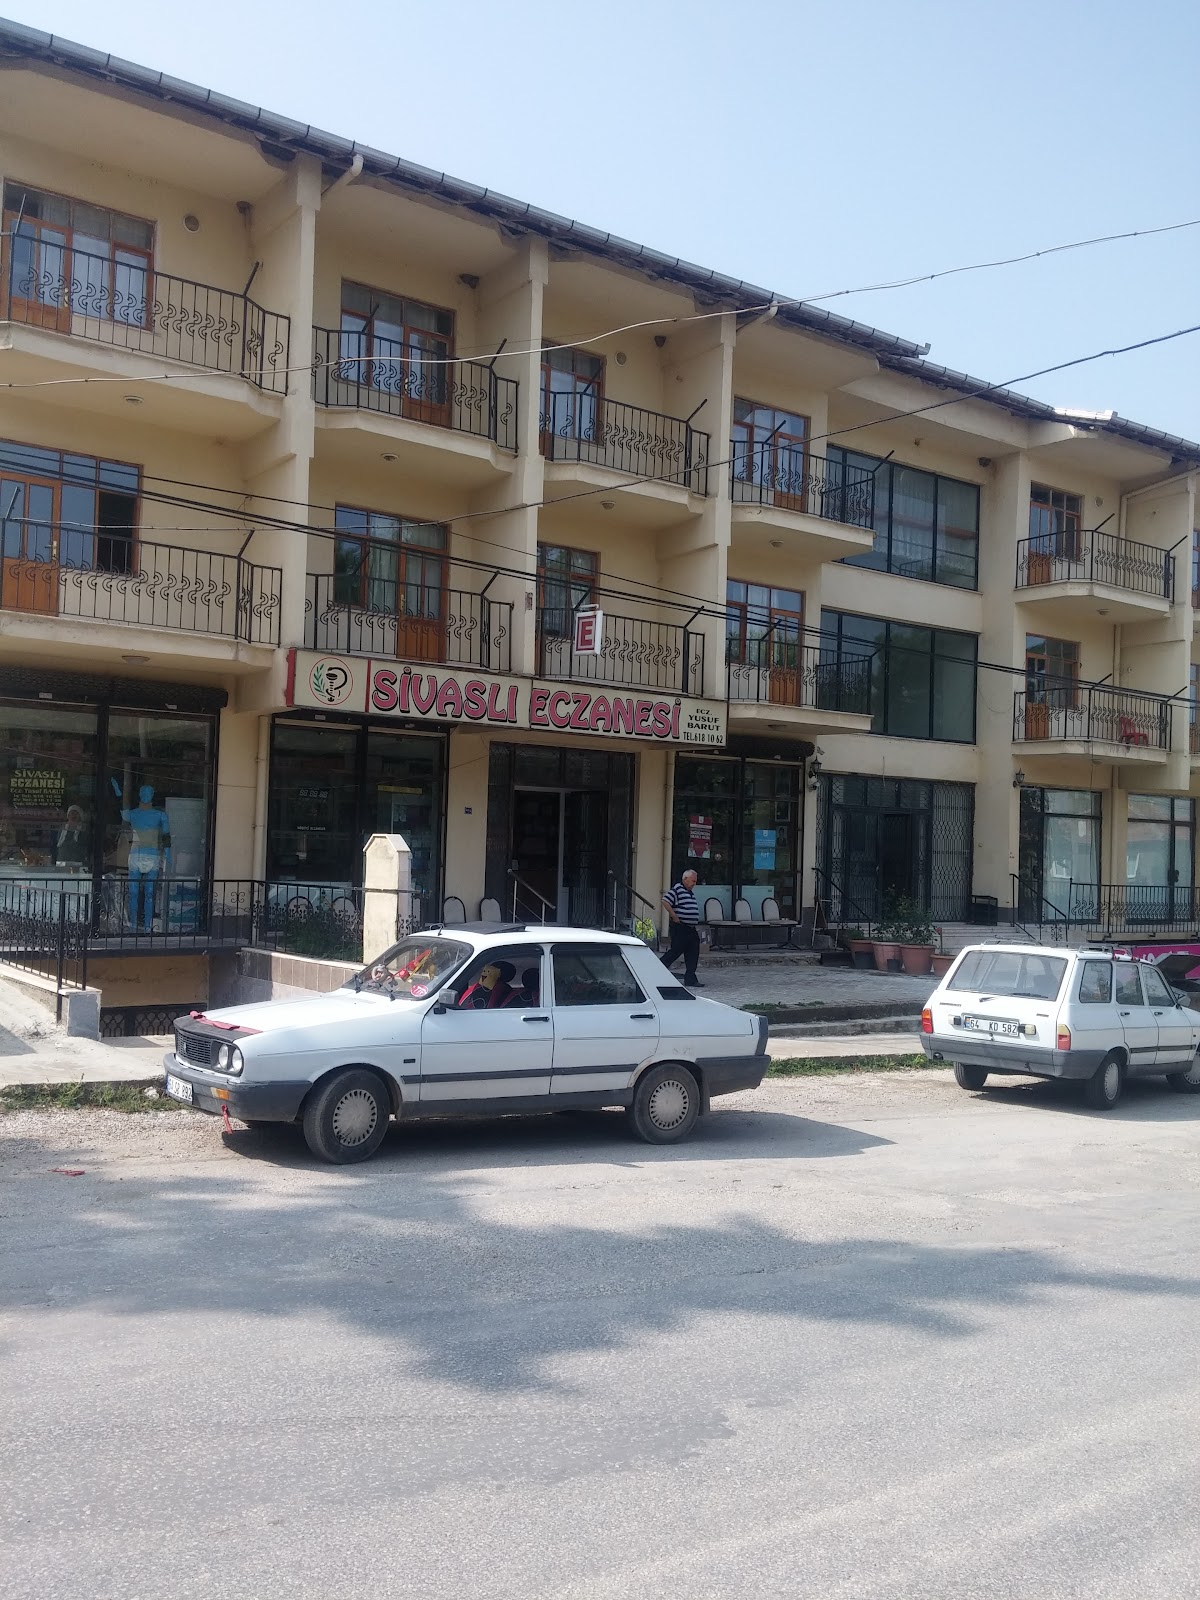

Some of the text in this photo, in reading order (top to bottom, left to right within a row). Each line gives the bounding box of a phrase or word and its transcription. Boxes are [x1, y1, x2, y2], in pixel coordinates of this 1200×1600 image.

[580, 620, 594, 647] E
[372, 667, 682, 739] SİVASLI ECZANESİ
[688, 715, 720, 723] YUSUF
[688, 723, 720, 731] BARUT
[10, 778, 65, 788] ECZANESİ
[989, 1022, 998, 1031] KD
[1002, 1024, 1016, 1033] 582
